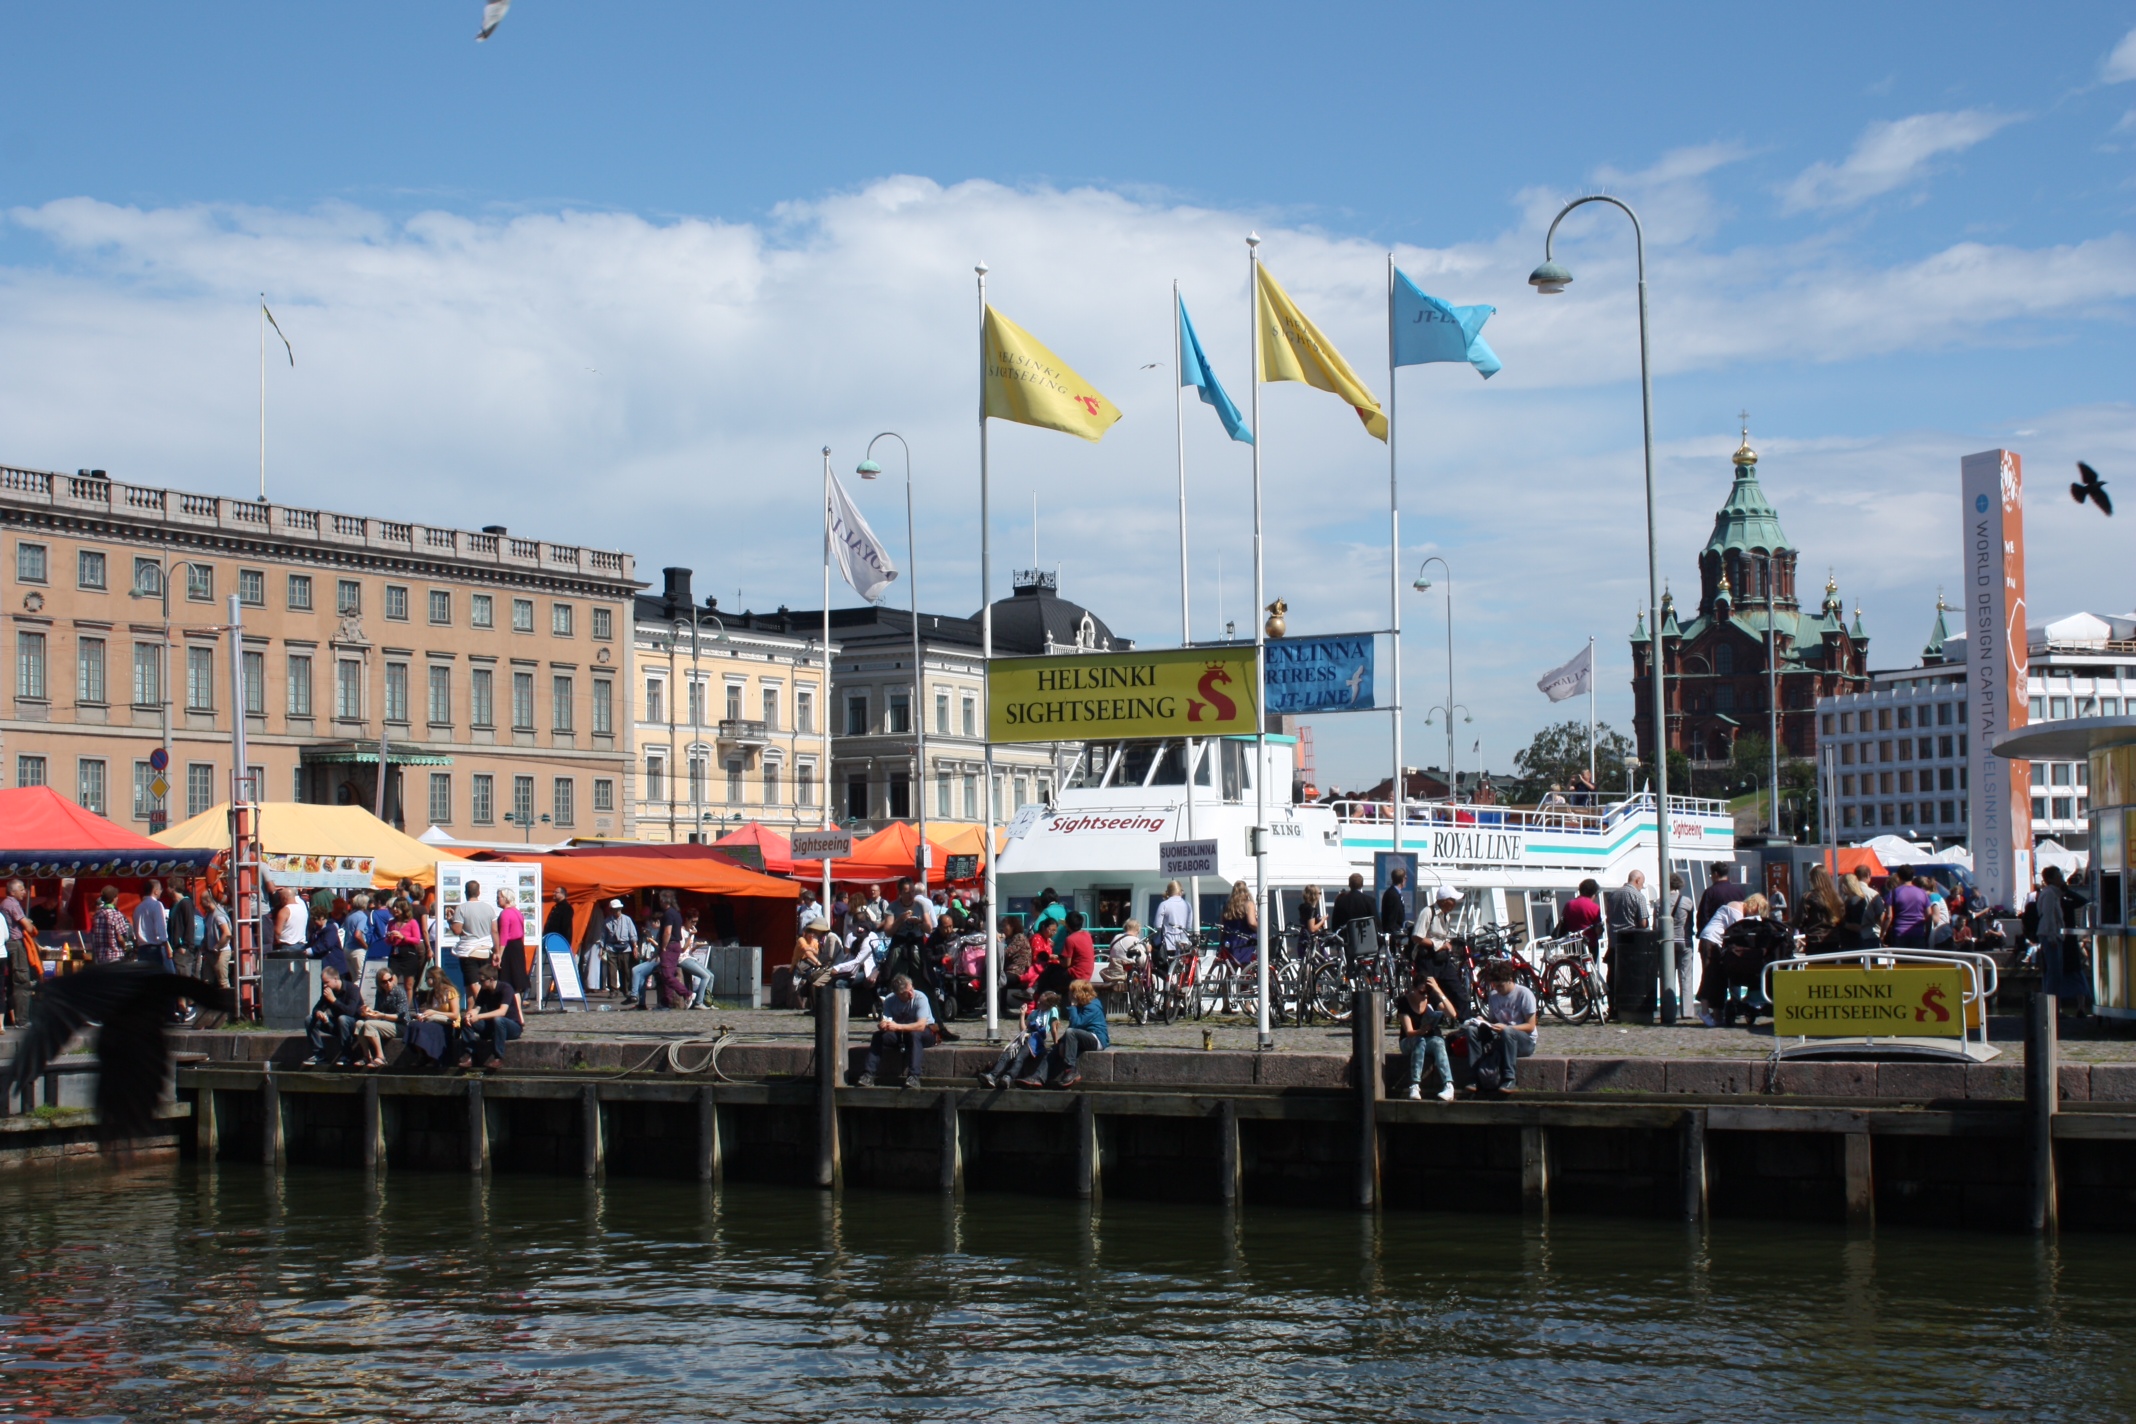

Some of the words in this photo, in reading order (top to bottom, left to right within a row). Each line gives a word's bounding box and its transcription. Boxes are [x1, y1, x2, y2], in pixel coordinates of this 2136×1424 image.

[1976, 519, 1991, 587] WORLD
[1978, 593, 1993, 660] DESIGN
[1265, 641, 1365, 664] ENLINNA
[1037, 664, 1157, 692] HELSINKI
[1264, 665, 1337, 685] RTRESS
[1275, 689, 1352, 708] JT-LINE
[1980, 666, 1996, 742] CAPITAL
[1006, 696, 1176, 725] SIGHTSEEING
[1983, 747, 1998, 830] HELSINKI
[1048, 814, 1166, 834] Sightseeing
[1271, 823, 1302, 837] KING
[1672, 818, 1703, 841] Sightseeing
[793, 835, 850, 856] Sightseeing
[1160, 844, 1217, 860] SUOMENLINNA
[1433, 831, 1484, 859] ROYAL
[1486, 834, 1521, 860] LINE
[1167, 859, 1211, 874] SVEABORG
[1985, 837, 1999, 878] 2012
[1807, 984, 1893, 999] HELSINKI
[1785, 1004, 1907, 1020] SIGHTSEEING
